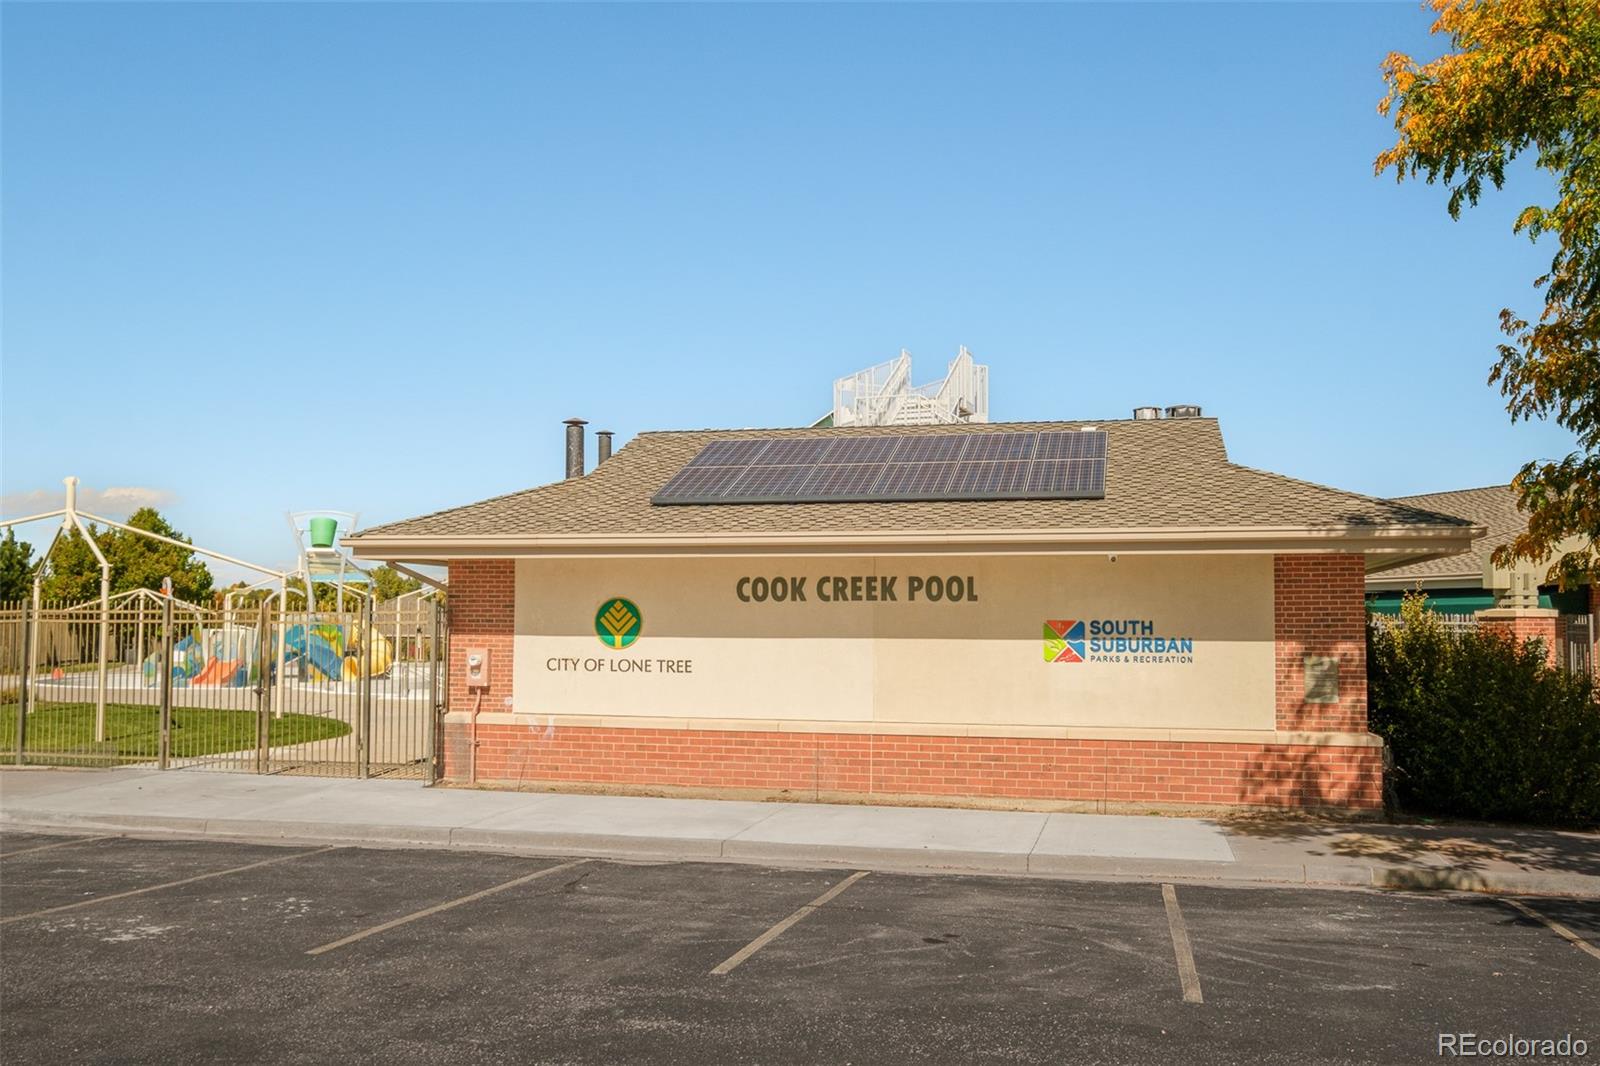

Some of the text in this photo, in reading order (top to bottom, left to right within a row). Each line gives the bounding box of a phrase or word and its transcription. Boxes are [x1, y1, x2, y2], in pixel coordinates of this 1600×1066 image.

[736, 575, 978, 602] COOK CREEK POOL
[1090, 620, 1153, 635] SOUTH
[1090, 637, 1193, 653] SUBURBAN
[546, 658, 692, 674] CITY OF LONE TREE
[1090, 655, 1193, 664] PARKS & RECREATION
